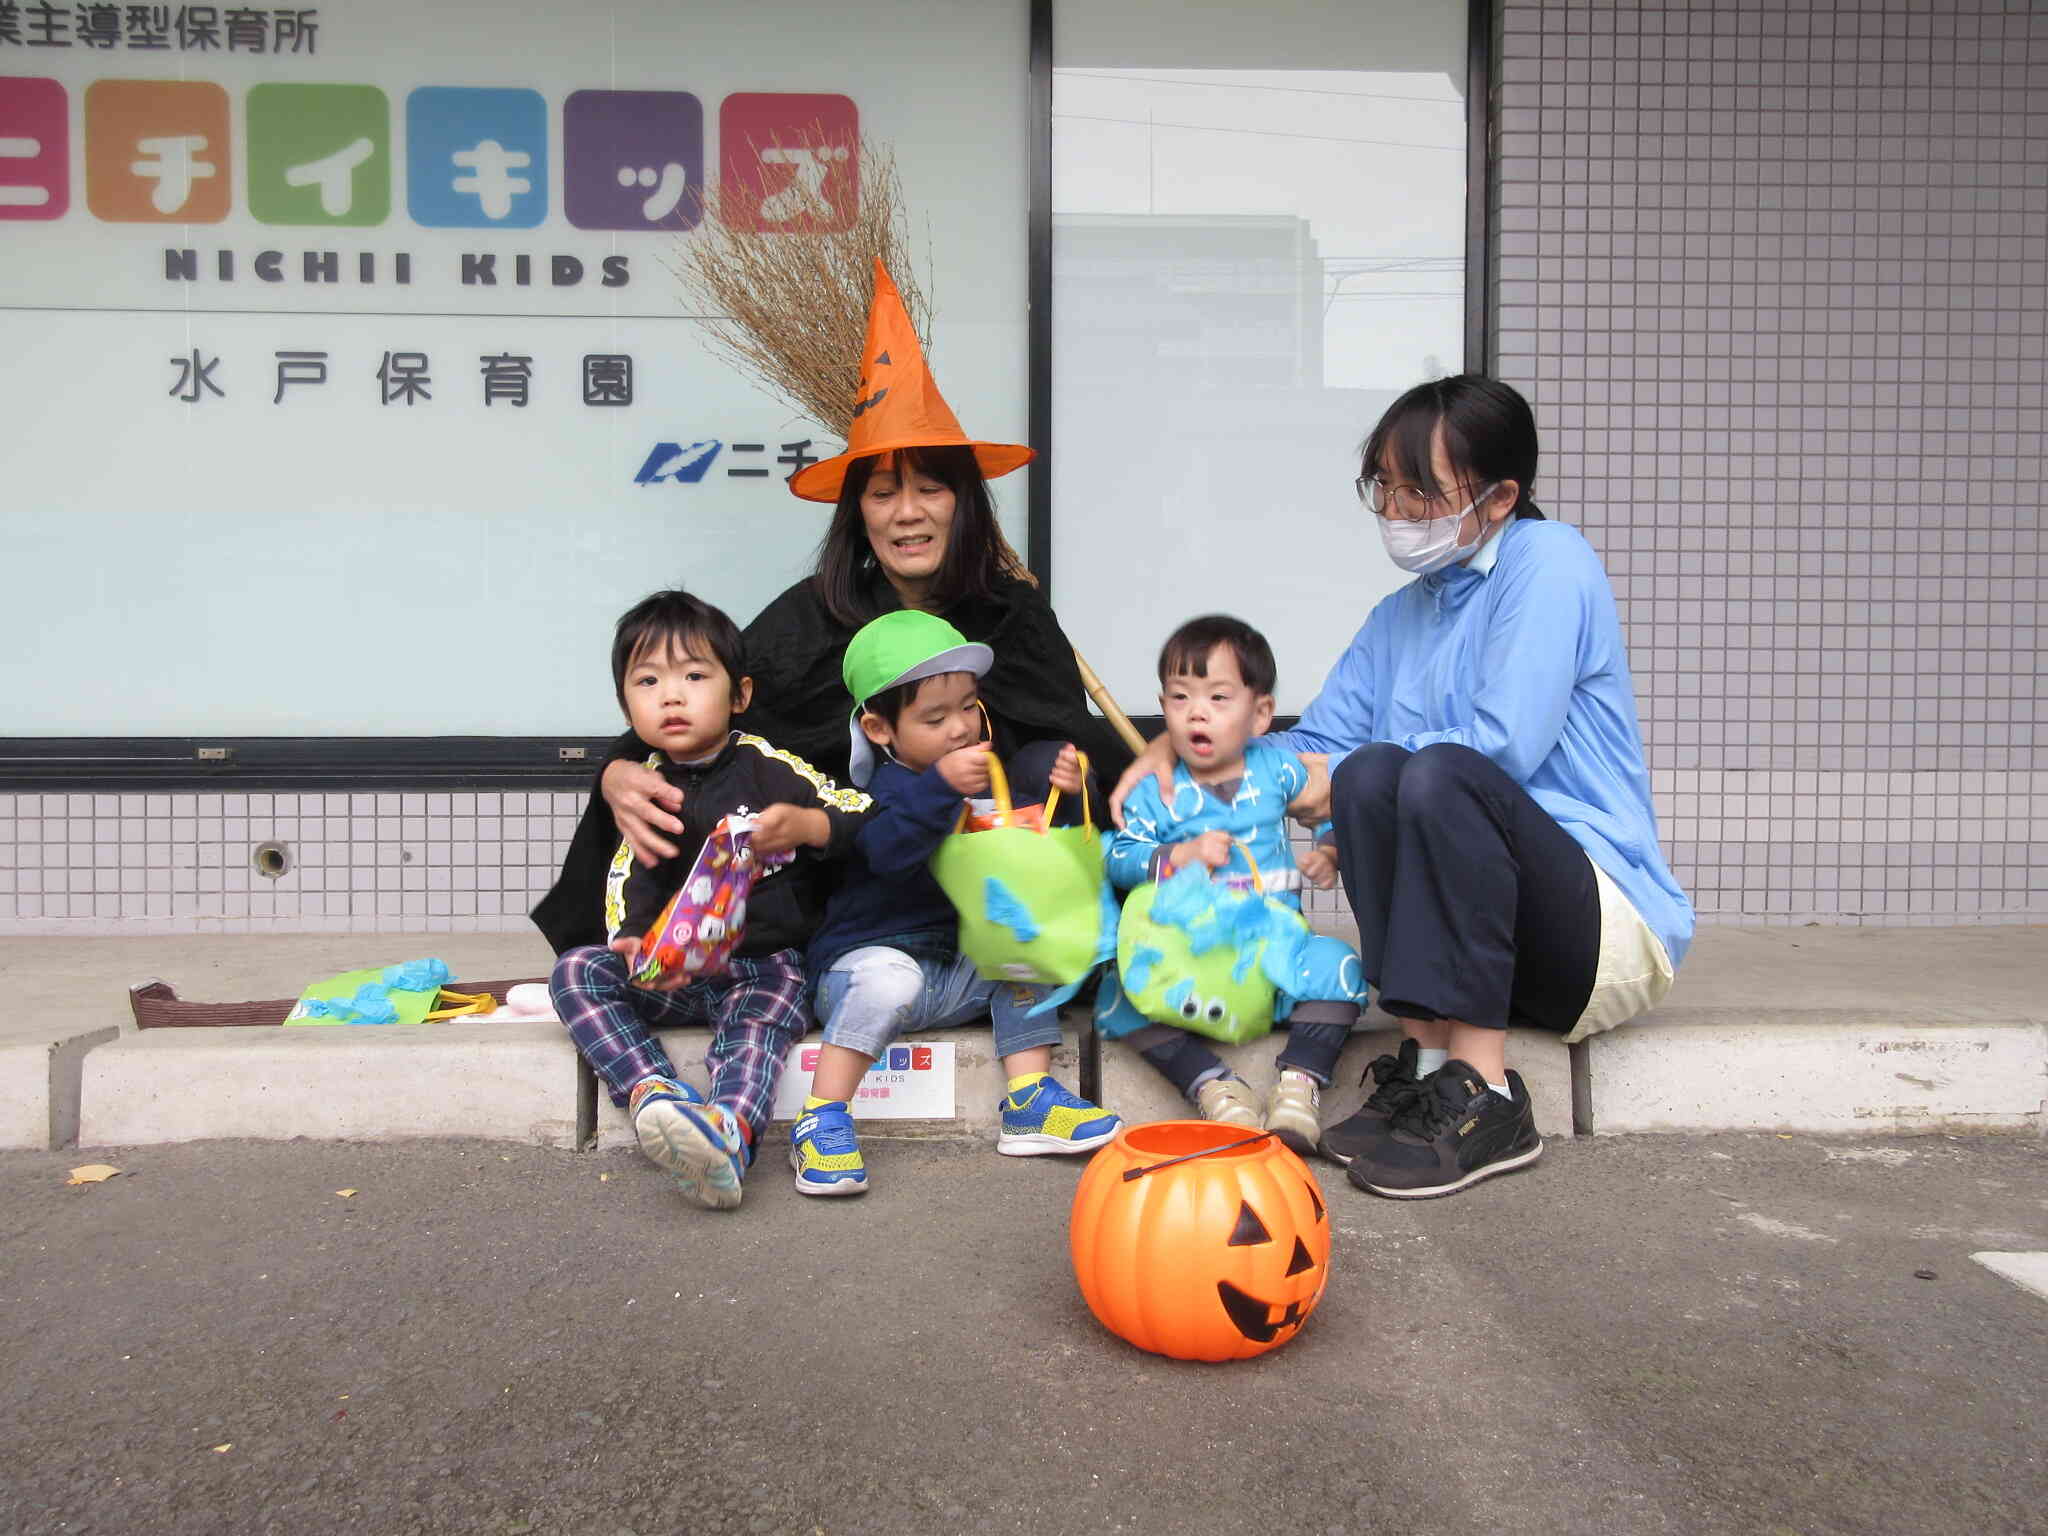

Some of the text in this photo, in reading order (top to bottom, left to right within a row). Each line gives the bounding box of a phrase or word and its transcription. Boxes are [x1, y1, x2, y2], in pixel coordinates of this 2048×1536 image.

[164, 248, 631, 288] NICHII KIDS
[168, 348, 634, 408] 水戸保育園
